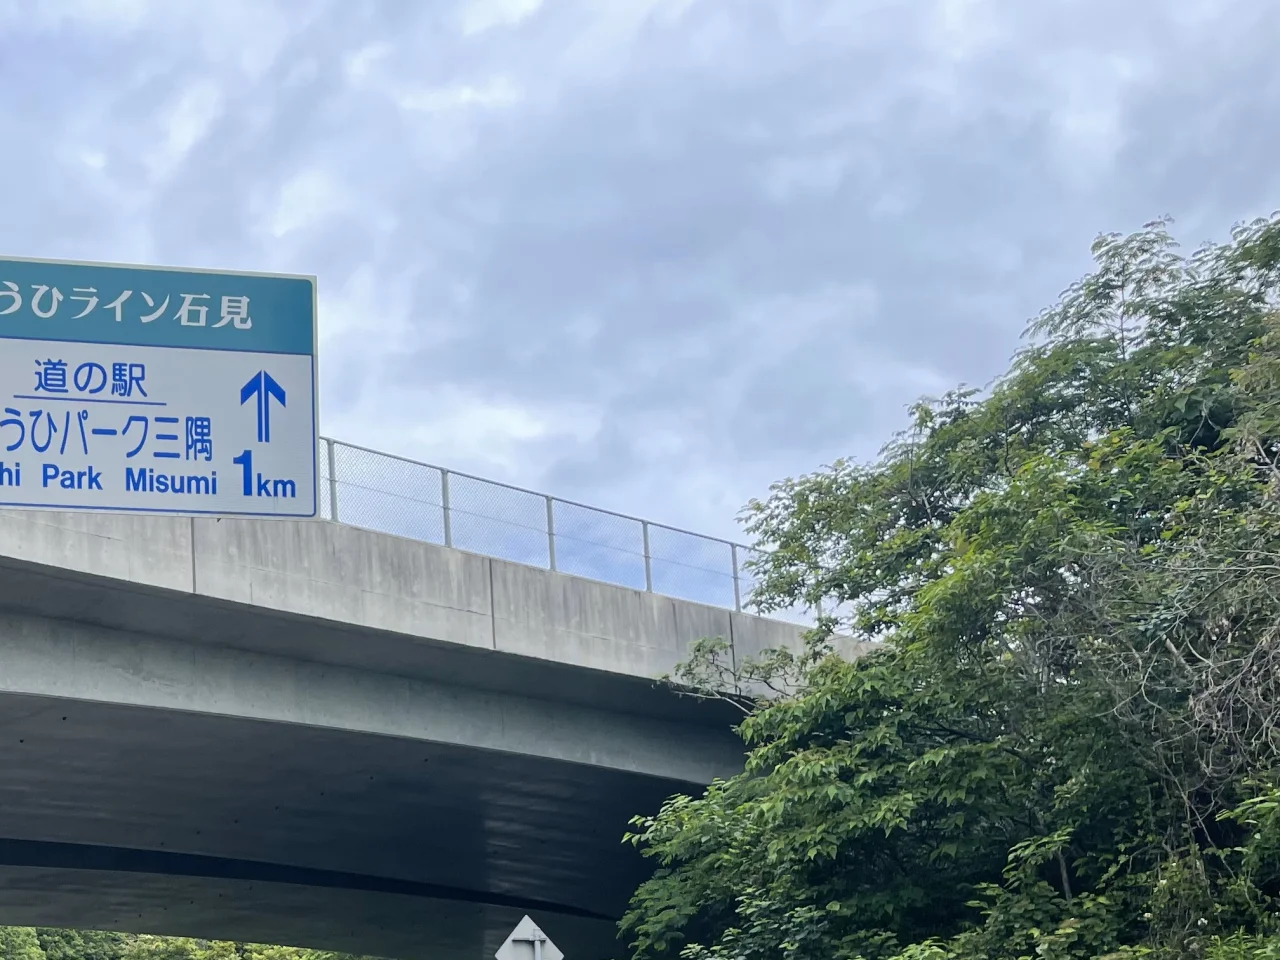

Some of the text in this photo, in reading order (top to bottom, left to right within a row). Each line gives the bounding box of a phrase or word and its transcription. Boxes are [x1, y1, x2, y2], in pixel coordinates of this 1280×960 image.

[34, 358, 148, 398] 道の駅
[41, 463, 103, 491] Park
[124, 467, 218, 496] Misumi
[232, 449, 297, 499] 1km
